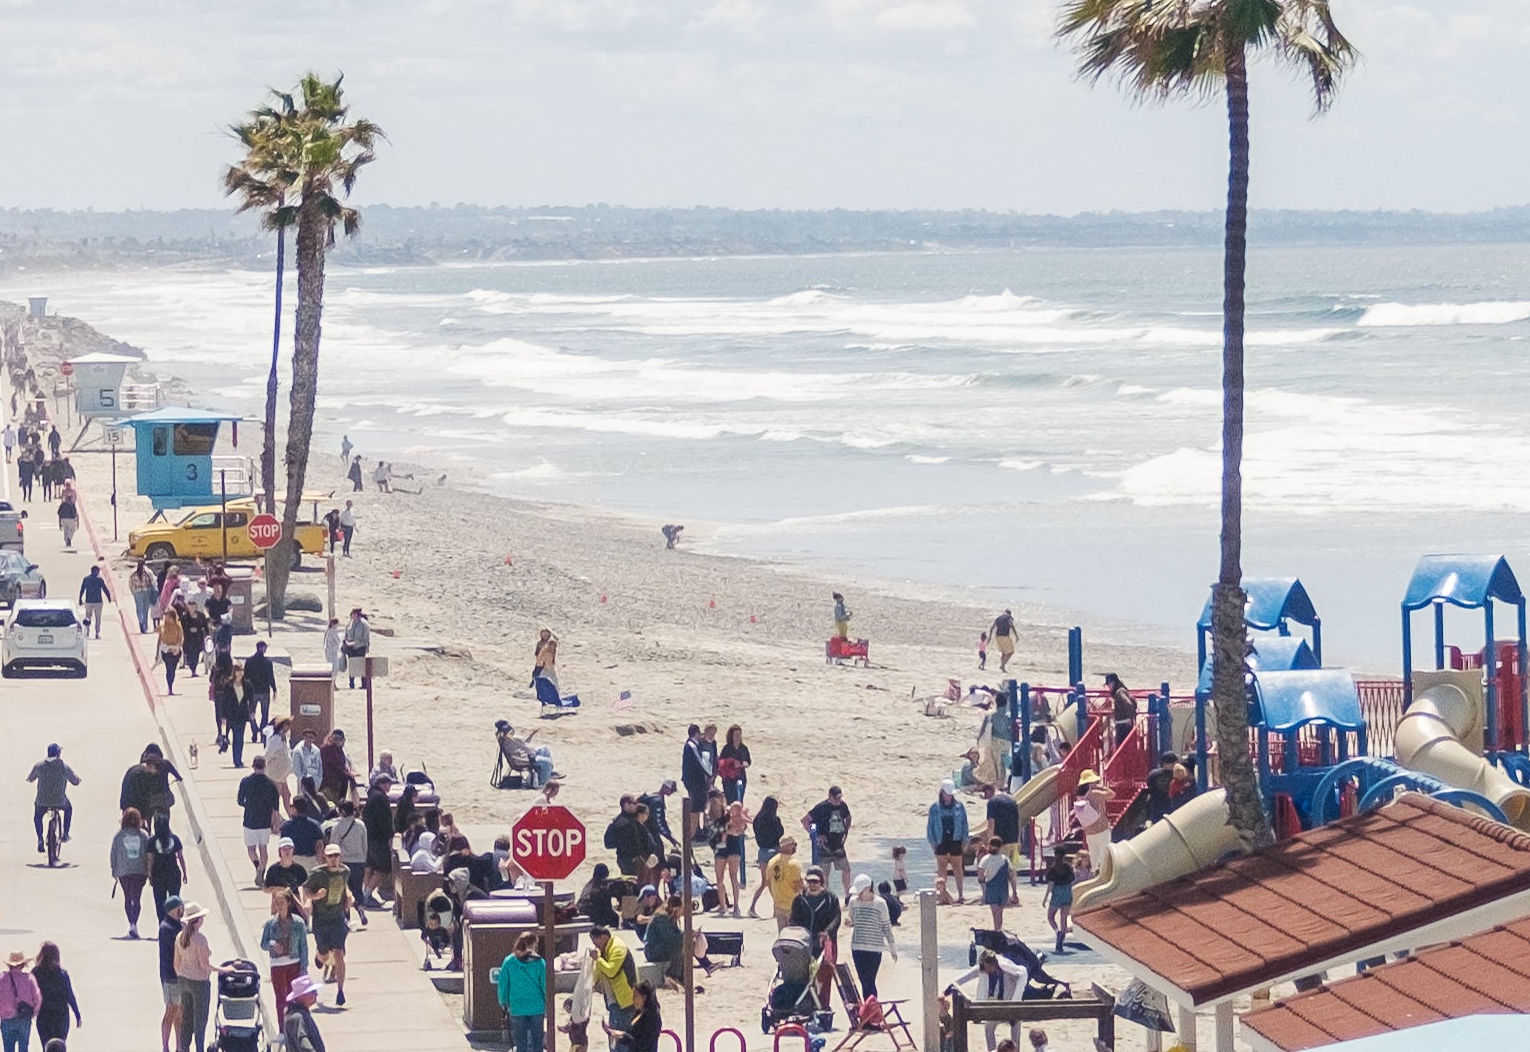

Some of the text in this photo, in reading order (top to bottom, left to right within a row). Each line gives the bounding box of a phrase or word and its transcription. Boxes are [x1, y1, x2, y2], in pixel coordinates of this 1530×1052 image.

[99, 389, 115, 408] 5
[107, 432, 120, 442] 15
[186, 463, 198, 481] 3
[249, 524, 280, 539] STOP
[516, 828, 582, 857] STOP
